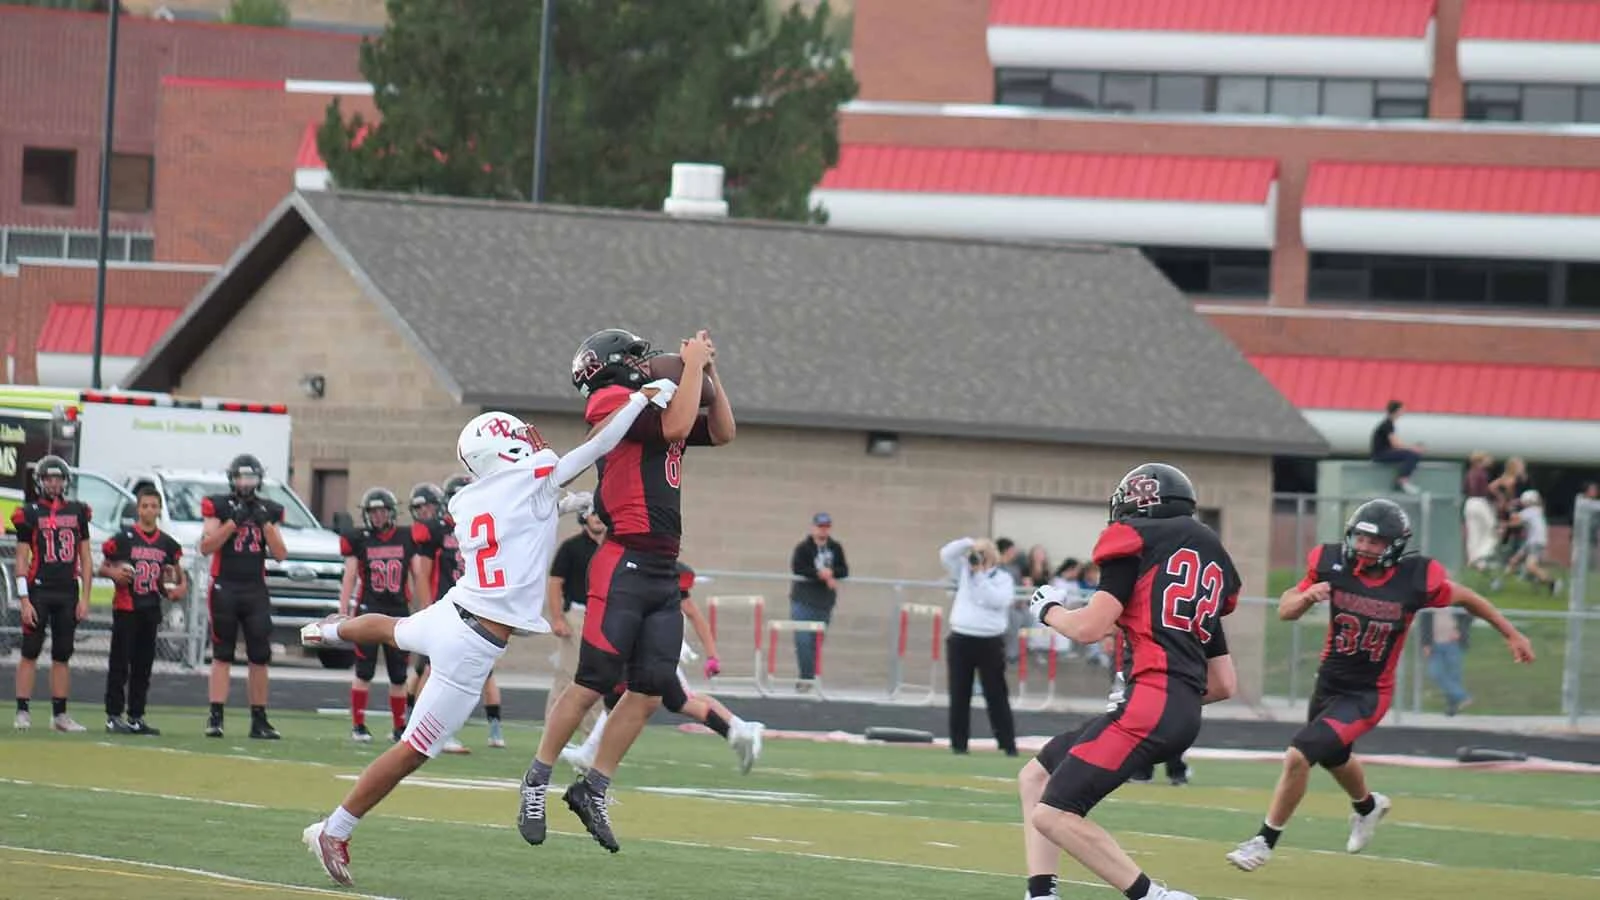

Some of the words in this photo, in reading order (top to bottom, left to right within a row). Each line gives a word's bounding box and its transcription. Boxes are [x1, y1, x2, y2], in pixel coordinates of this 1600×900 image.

[1124, 474, 1161, 507] KR
[42, 527, 75, 563] 13
[234, 527, 262, 553] 71
[469, 510, 506, 590] 2
[1161, 547, 1223, 643] 22
[1335, 612, 1393, 663] 34
